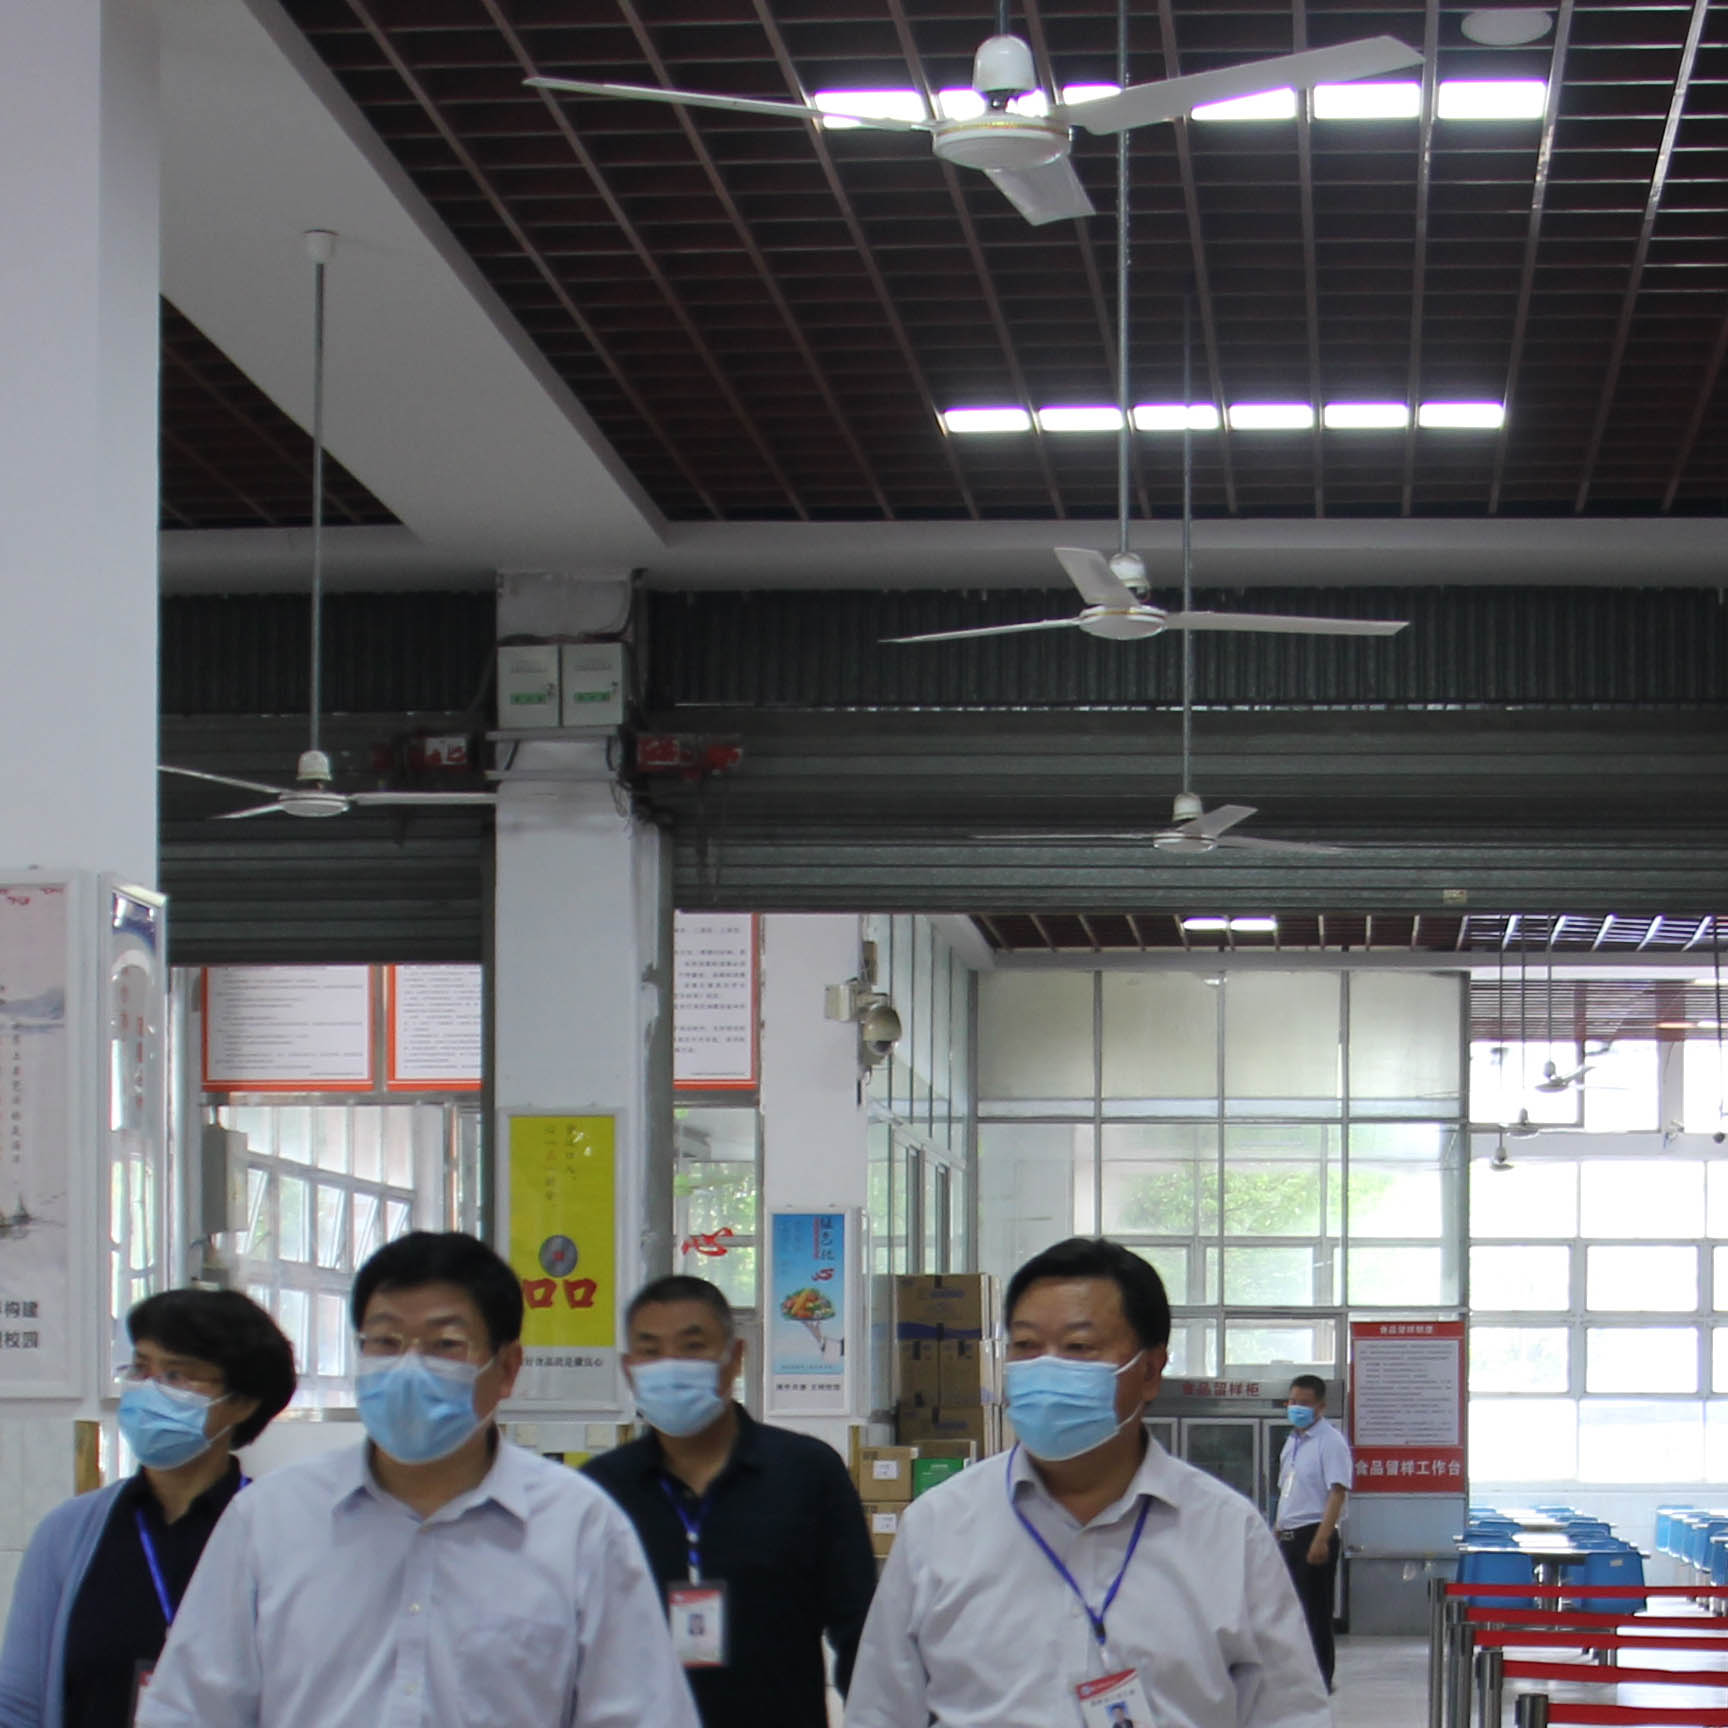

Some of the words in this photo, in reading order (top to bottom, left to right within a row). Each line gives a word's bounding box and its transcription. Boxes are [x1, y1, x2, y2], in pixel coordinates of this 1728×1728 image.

[1183, 1382, 1259, 1396] 食品留样柜
[1355, 1460, 1461, 1476] 食品留样工作台
